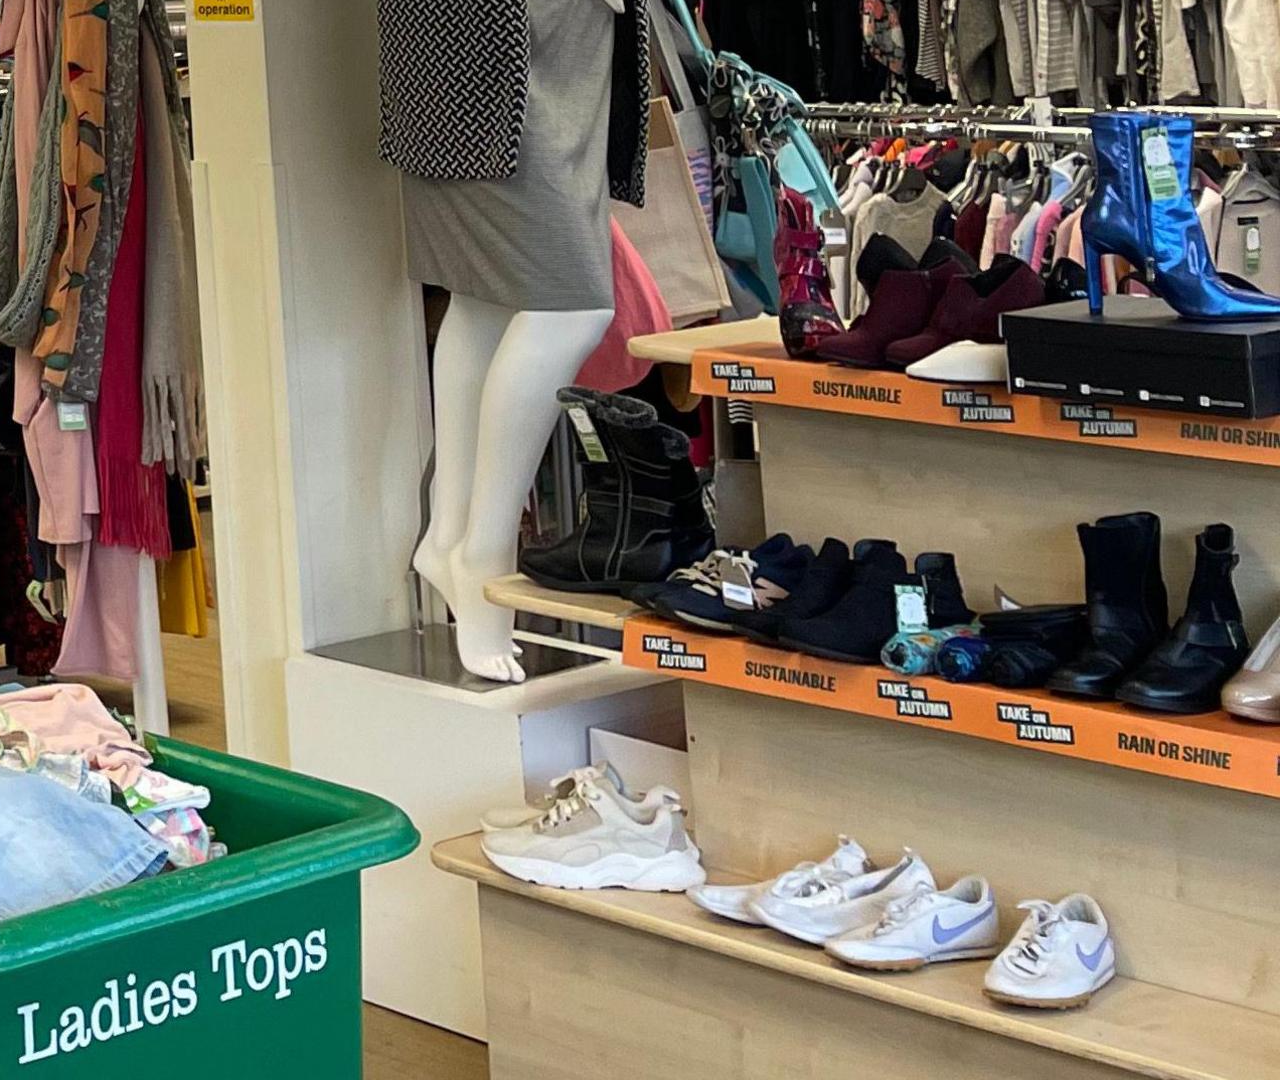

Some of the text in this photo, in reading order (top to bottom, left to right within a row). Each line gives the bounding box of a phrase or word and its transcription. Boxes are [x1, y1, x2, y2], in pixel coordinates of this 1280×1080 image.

[198, 4, 250, 17] operation
[713, 364, 739, 378] TAKE
[730, 378, 774, 393] AUTUMN
[813, 380, 902, 405] SUSTAINABLE
[944, 391, 974, 405] TAKE
[962, 407, 1013, 421] AUTUMN
[1063, 405, 1093, 419] TAKE
[1082, 422, 1134, 436] AUTUMN
[1180, 423, 1218, 442] RAIN
[1222, 426, 1244, 445] OR
[644, 636, 671, 650] TAKE
[660, 654, 704, 670] AUTUMN
[745, 661, 836, 692] SUSTAINABLE
[879, 682, 909, 698] TAKE
[899, 700, 950, 718] AUTUMN
[998, 705, 1030, 721] TAKE
[1019, 725, 1072, 742] AUTUMN
[1118, 732, 1232, 770] RAIN OR SHINE
[16, 926, 329, 1065] Ladies Tops
